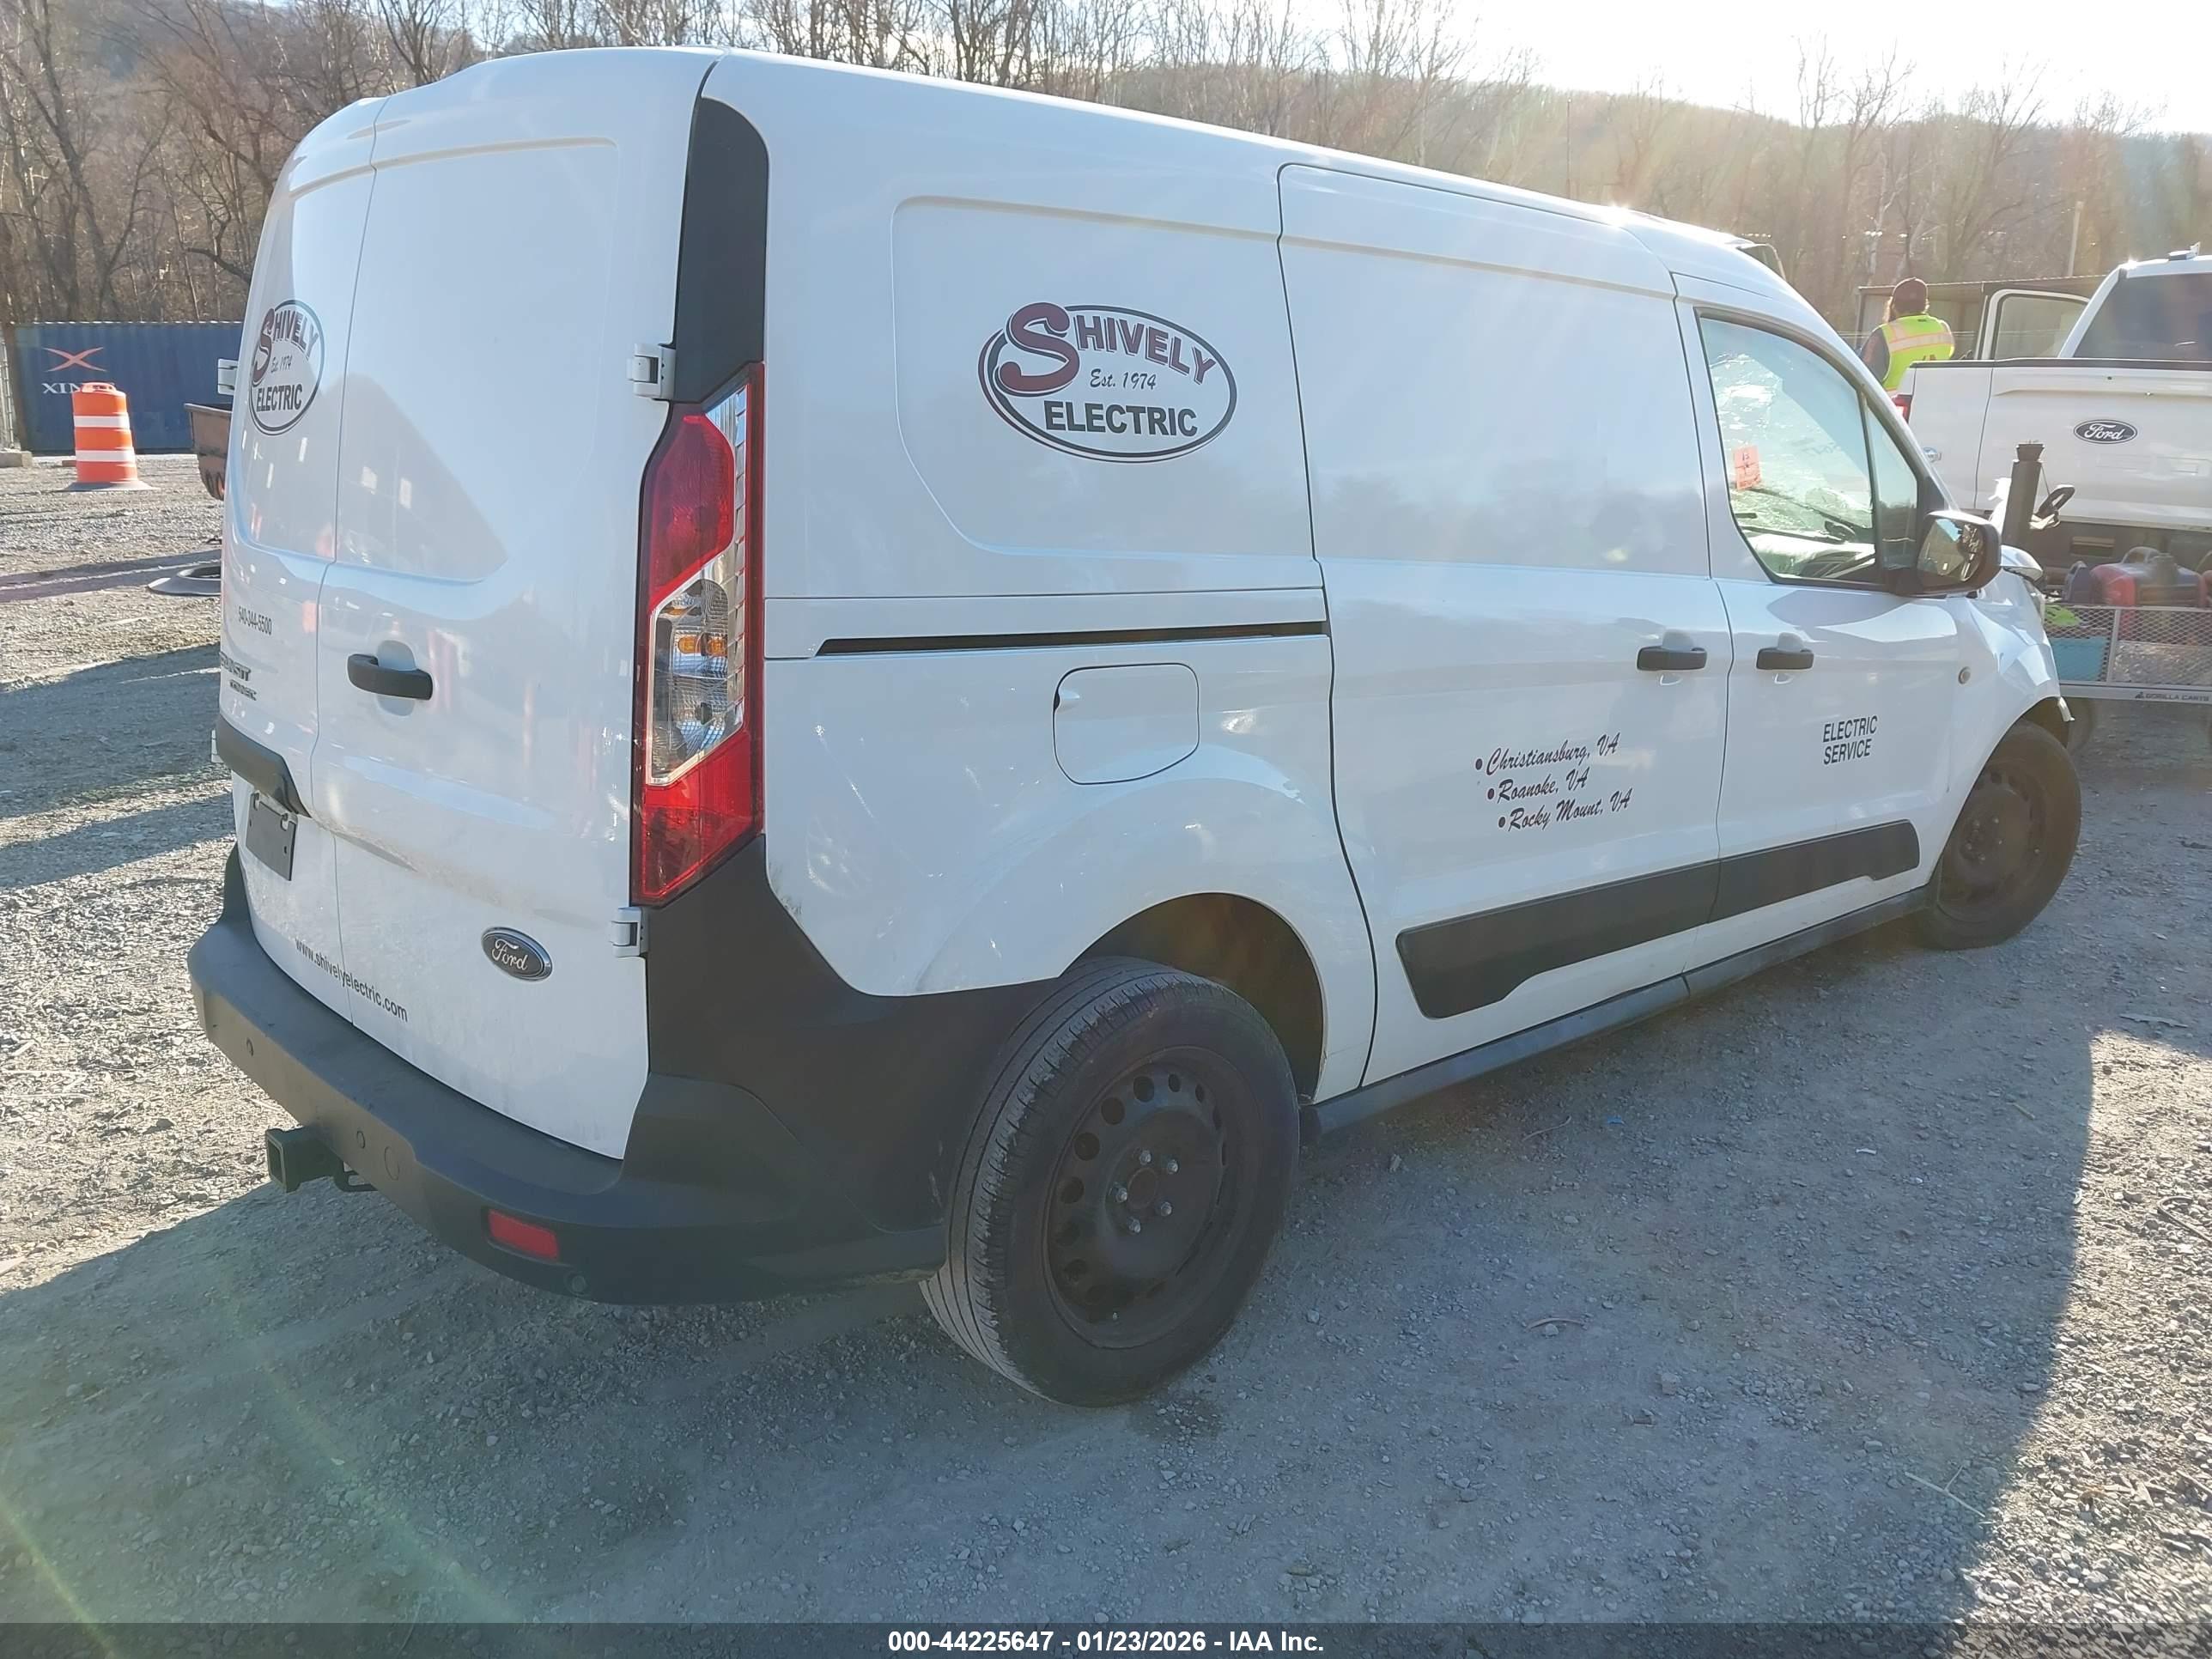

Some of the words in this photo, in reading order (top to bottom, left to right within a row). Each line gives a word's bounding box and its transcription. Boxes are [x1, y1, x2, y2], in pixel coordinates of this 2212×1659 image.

[252, 307, 319, 387] SHIVELY
[995, 301, 1217, 398] SHIVELY
[1090, 368, 1116, 388] Est.
[1122, 371, 1157, 391] 1974
[256, 383, 303, 412] ELECTRIC
[1043, 400, 1198, 437] ELECTRIC
[2084, 422, 2125, 440] Ford
[239, 605, 272, 635] 540-344-5500
[1823, 715, 1878, 743] ELECTRIC
[1486, 739, 1590, 775] Christiansburg,
[1596, 732, 1620, 757] VA
[1824, 738, 1872, 765] SERVICE
[1497, 774, 1559, 804] Roanoke,
[1565, 767, 1590, 791] VA
[1508, 805, 1550, 832] Rocky
[1556, 799, 1603, 822] Mount,
[1609, 788, 1633, 812] VA
[491, 939, 529, 970] Ford
[295, 938, 408, 1022] www.shivelyelectric.com
